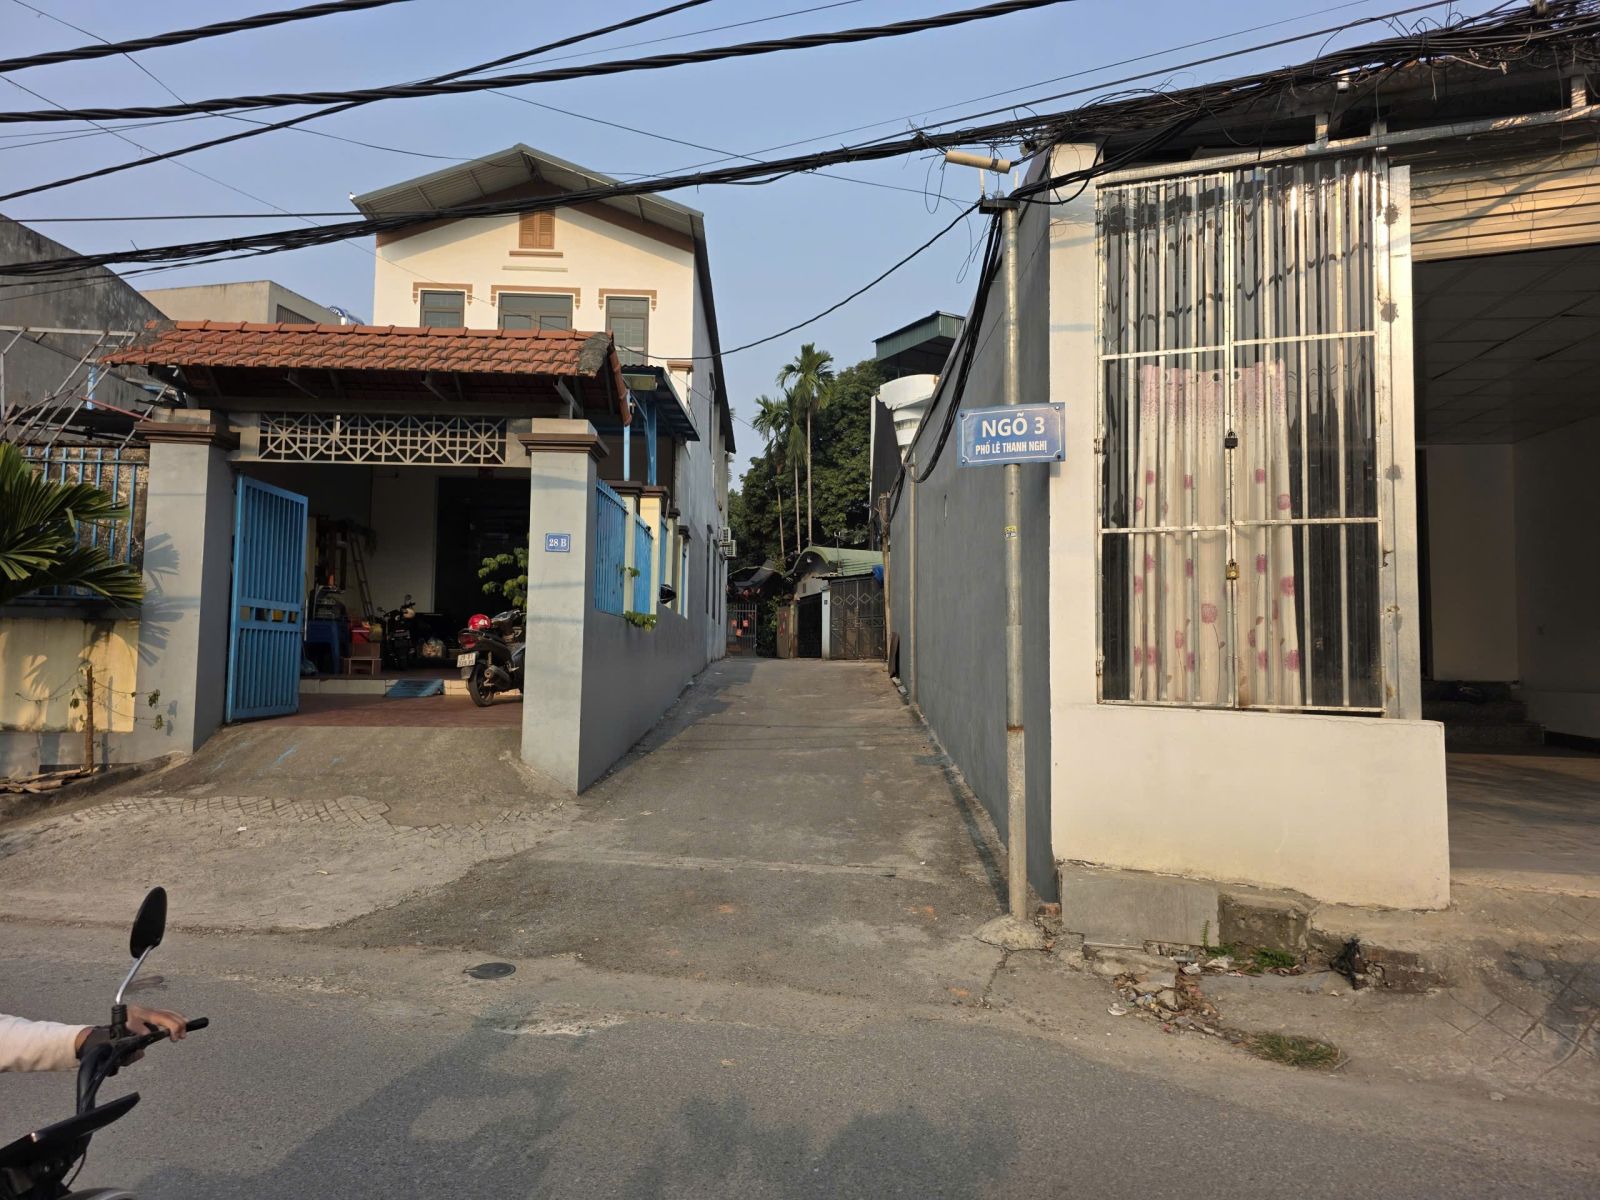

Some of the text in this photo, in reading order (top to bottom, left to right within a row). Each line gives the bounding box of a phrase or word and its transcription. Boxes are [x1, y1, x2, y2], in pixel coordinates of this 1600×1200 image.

[982, 412, 1045, 438] NGÕ 3
[976, 440, 1047, 455] PHỐ LÊ THANH NGHỊ
[549, 538, 567, 547] 28 B
